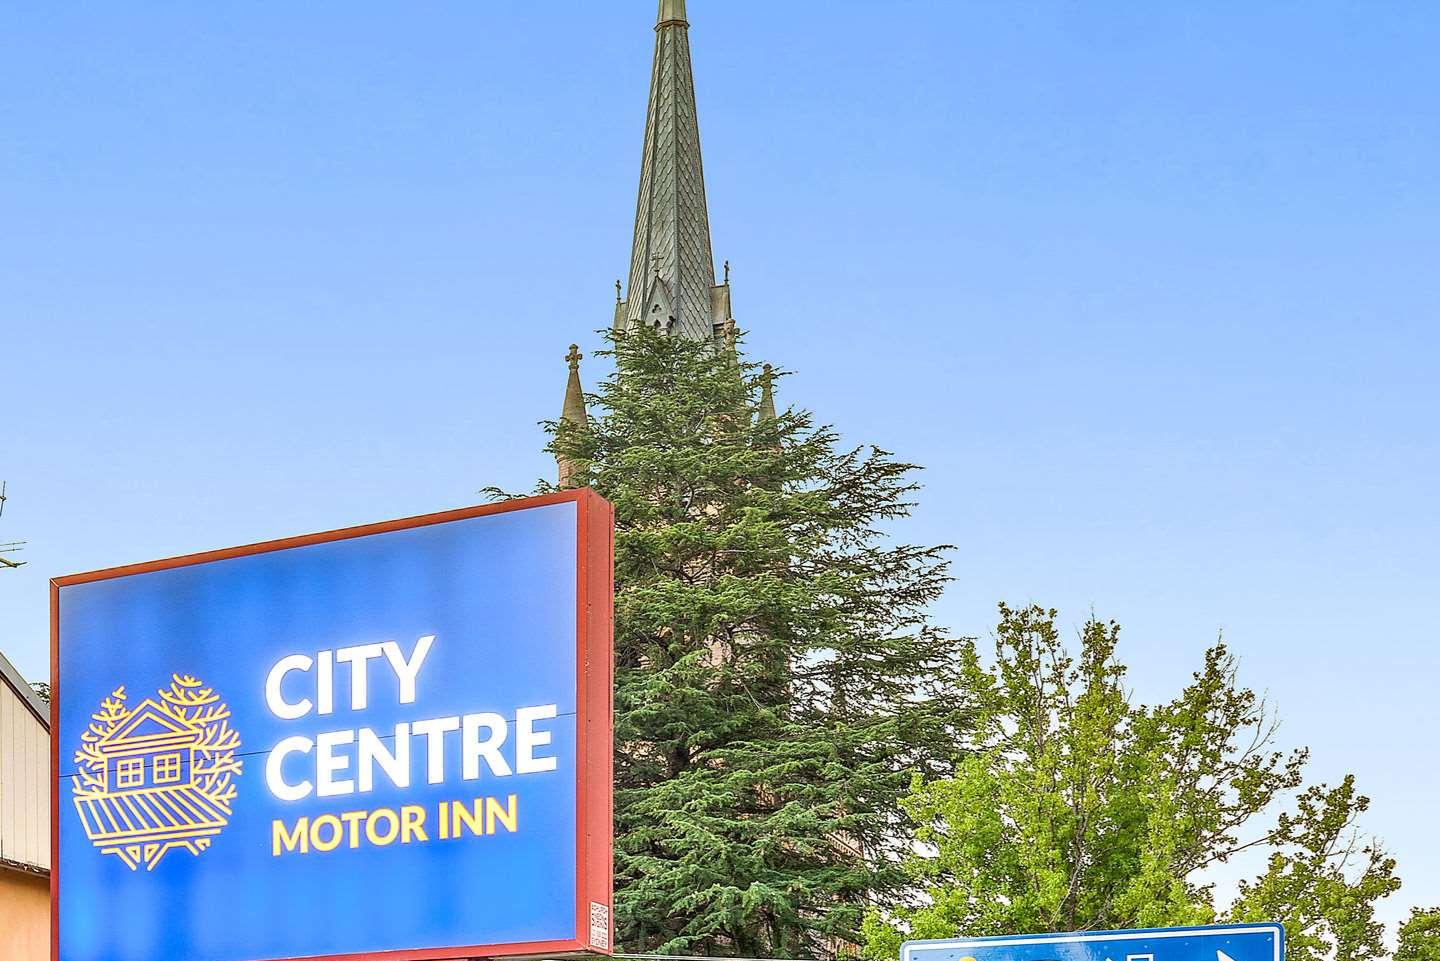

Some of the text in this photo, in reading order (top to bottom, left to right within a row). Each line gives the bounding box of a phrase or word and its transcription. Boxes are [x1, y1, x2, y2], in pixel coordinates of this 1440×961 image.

[265, 635, 437, 720] CITY
[265, 703, 558, 801] CENTRE
[272, 794, 518, 857] MOTOR INN
